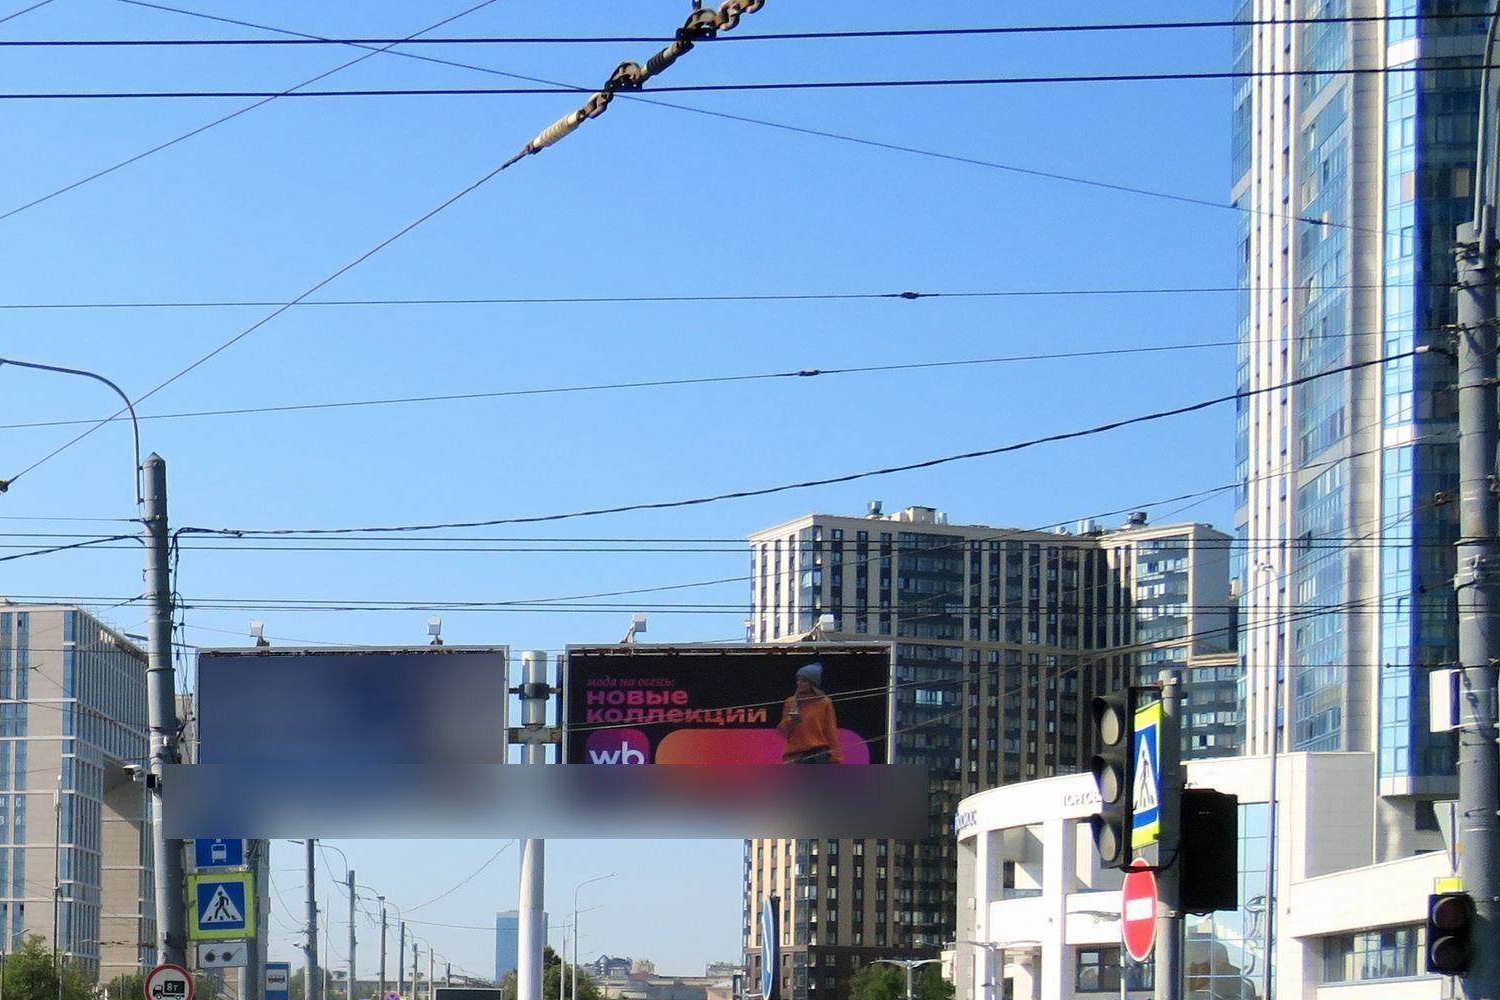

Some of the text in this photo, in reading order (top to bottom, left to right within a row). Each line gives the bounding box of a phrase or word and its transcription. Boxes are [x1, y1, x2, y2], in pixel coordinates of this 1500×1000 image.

[586, 675, 619, 687] мода
[620, 678, 635, 687] на
[586, 689, 689, 705] новые
[586, 707, 768, 726] коллекции
[588, 740, 645, 764] wb
